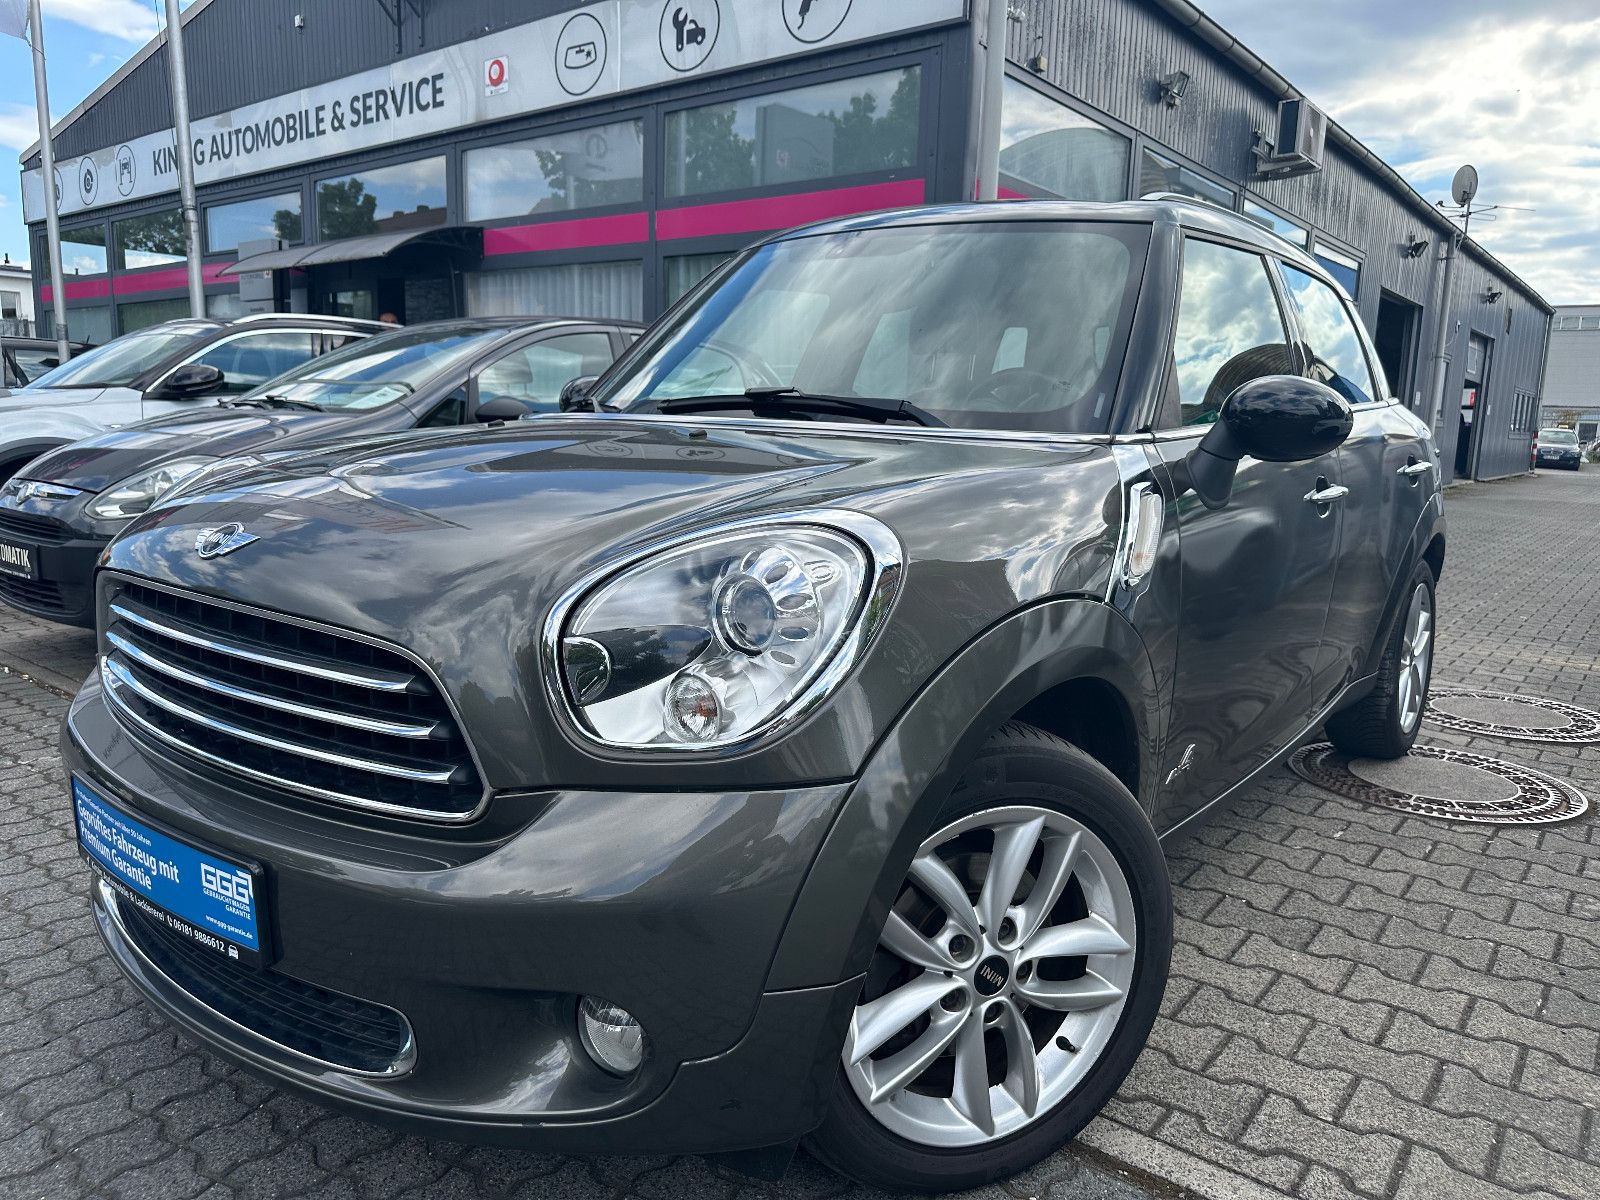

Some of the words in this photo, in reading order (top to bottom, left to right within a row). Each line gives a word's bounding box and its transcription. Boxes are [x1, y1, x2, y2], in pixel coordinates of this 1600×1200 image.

[209, 104, 326, 163] AUTOMOBILE
[331, 101, 346, 131] &
[350, 73, 445, 128] SERVICE
[0, 543, 30, 568] OMATIK
[78, 800, 111, 842] Geprüftes
[112, 827, 157, 876] Fahrzeug
[159, 860, 179, 884] mit
[80, 820, 112, 862] Premium
[112, 848, 152, 890] Garantie
[203, 887, 250, 912] GEBRAUCHTWAGEN
[225, 904, 251, 921] GARANTIE
[173, 918, 193, 937] 06181
[194, 929, 225, 952] 9886612
[205, 915, 253, 940] www.ggg-garantie.de
[980, 964, 1004, 987] MINI
